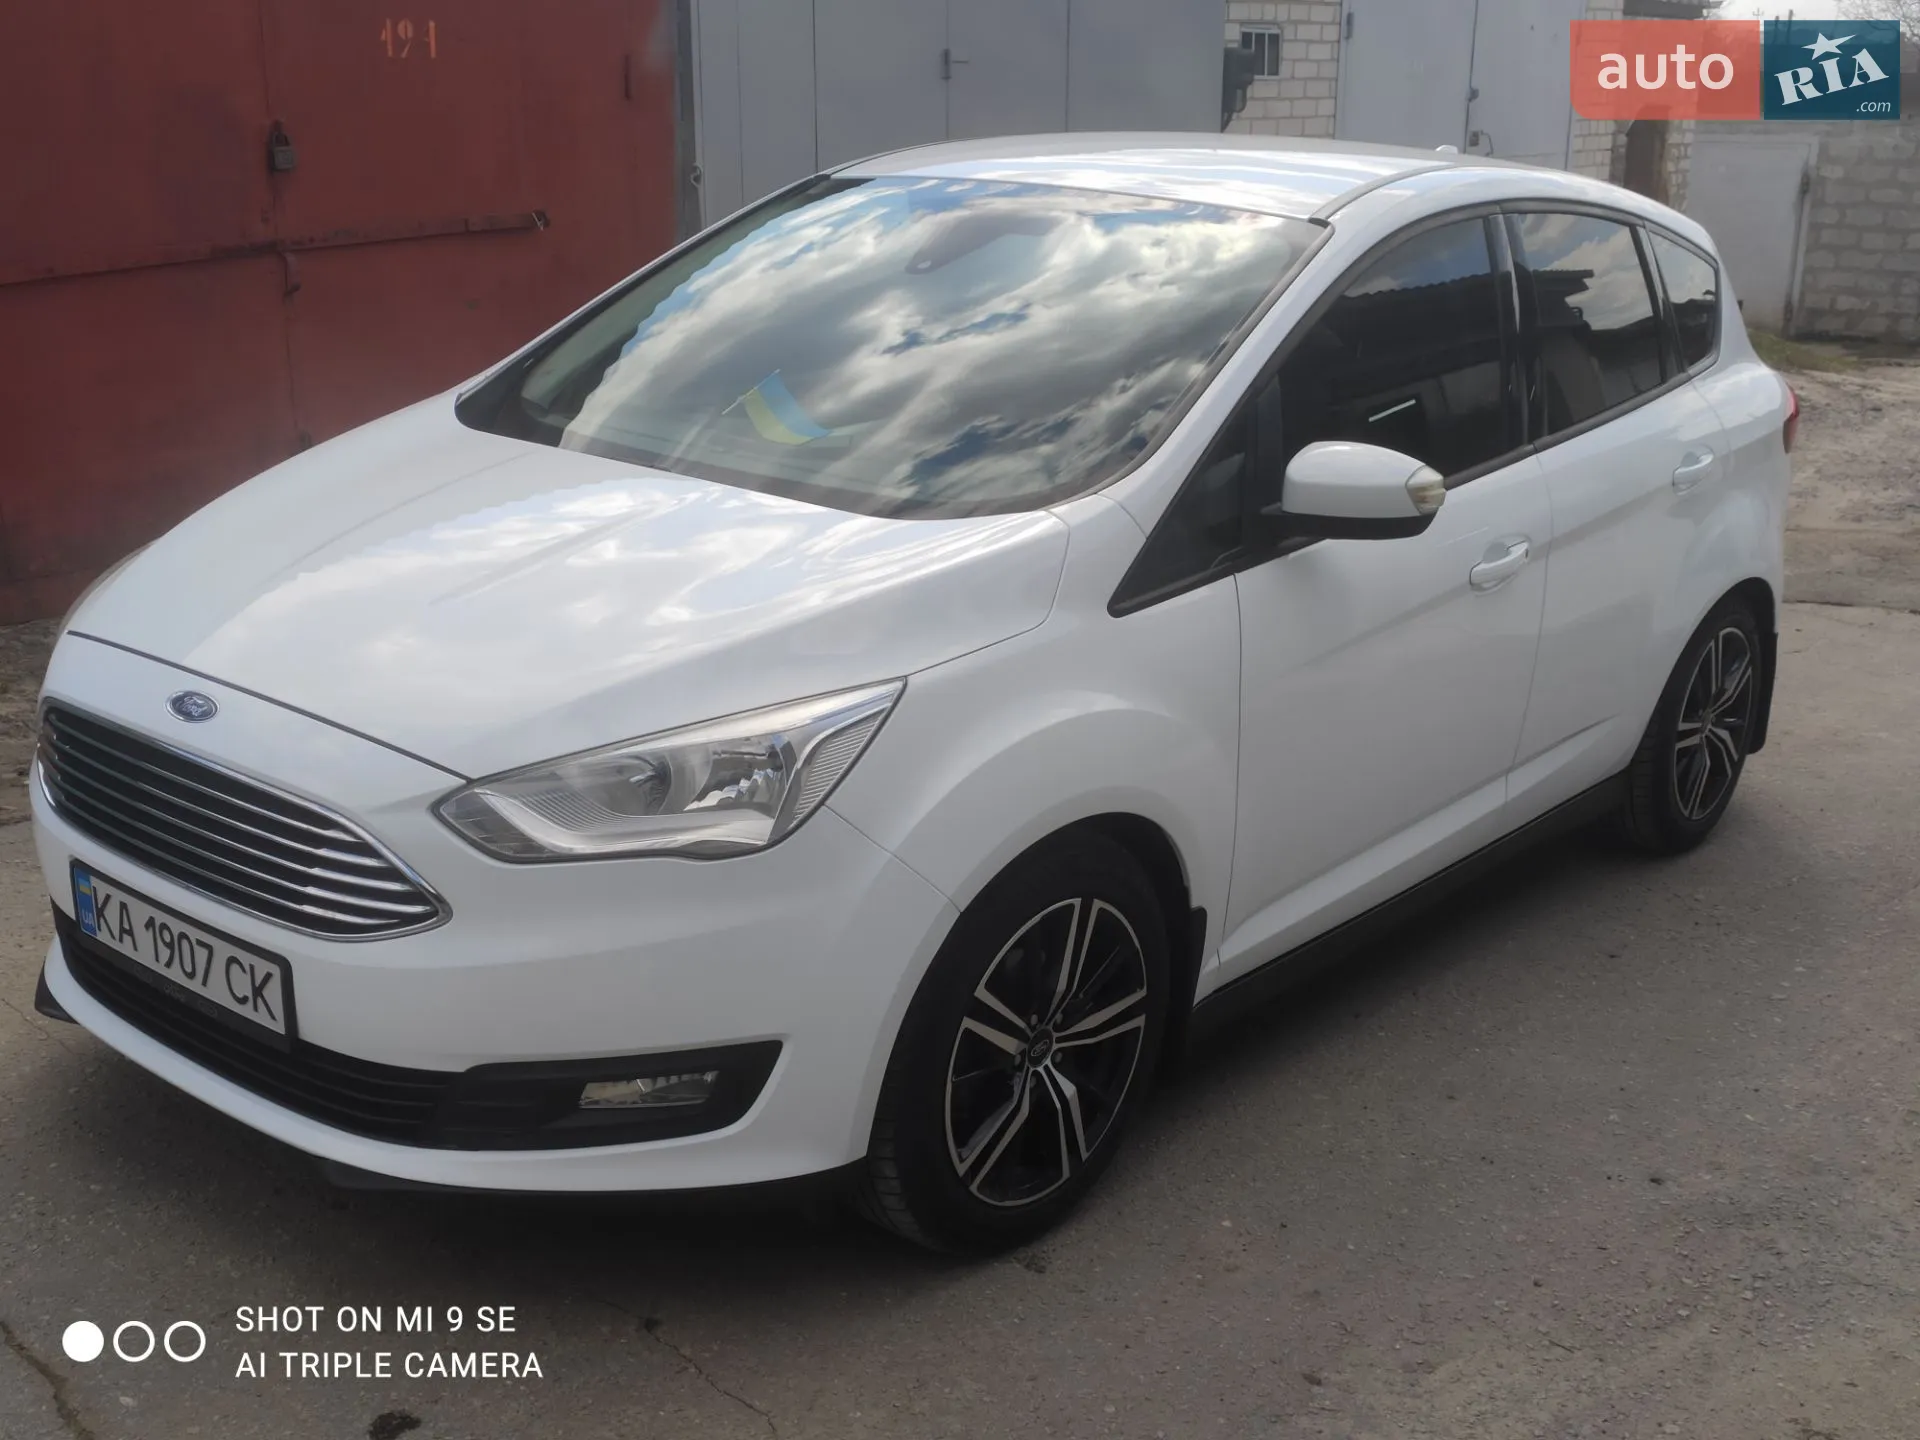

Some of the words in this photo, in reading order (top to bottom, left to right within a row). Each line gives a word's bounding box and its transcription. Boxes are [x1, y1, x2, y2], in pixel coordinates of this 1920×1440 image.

[81, 908, 96, 927] UA
[92, 885, 139, 952] KA
[144, 915, 214, 988] 1907
[225, 955, 278, 1022] CK
